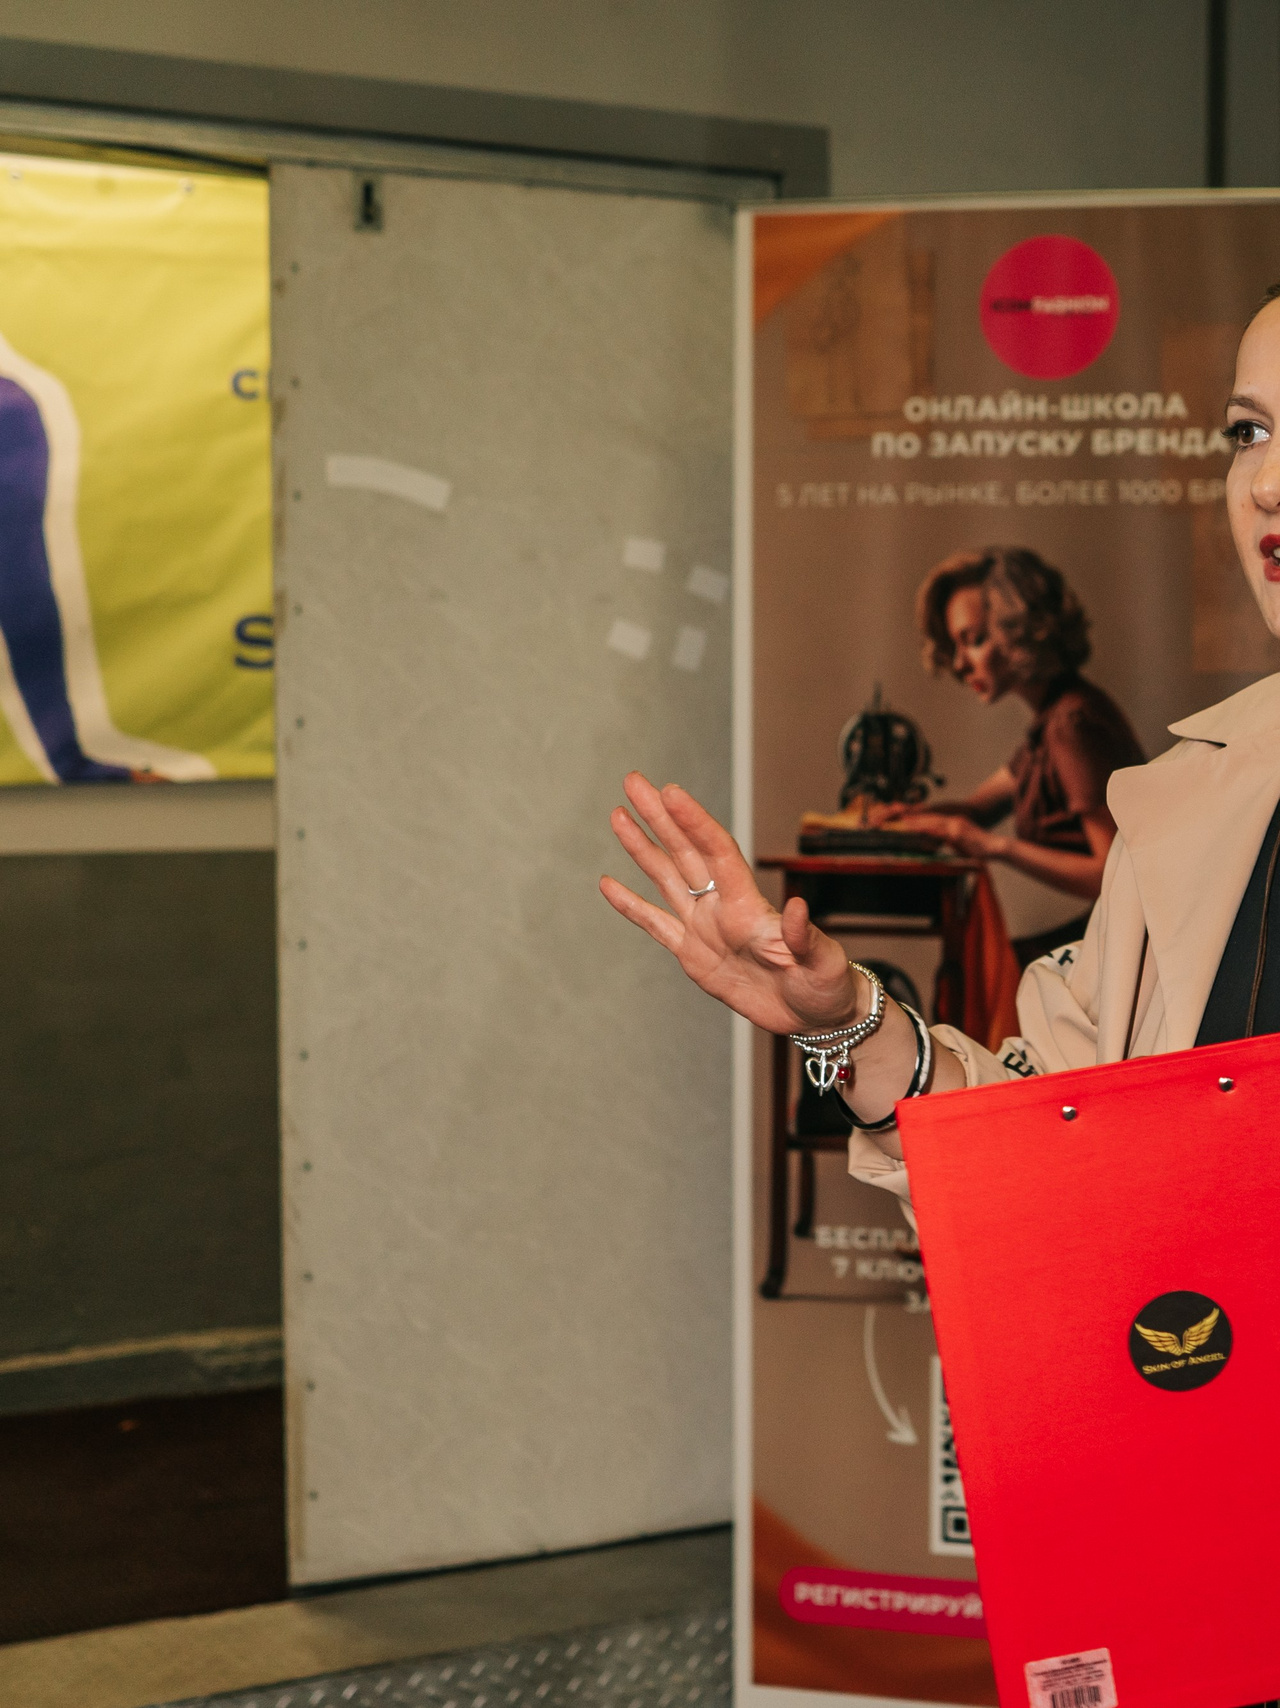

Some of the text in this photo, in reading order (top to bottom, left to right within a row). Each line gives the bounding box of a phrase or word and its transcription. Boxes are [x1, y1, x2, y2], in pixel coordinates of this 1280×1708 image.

[904, 391, 1187, 422] ОНЛАЙН-ШКОЛА
[871, 433, 922, 459] ПО
[930, 428, 1082, 459] ЗАПУСКУ
[799, 483, 851, 508] ЛЕТ
[857, 482, 899, 506] НА
[1016, 479, 1111, 506] БОЛЕЕ
[1119, 478, 1179, 504] 1000
